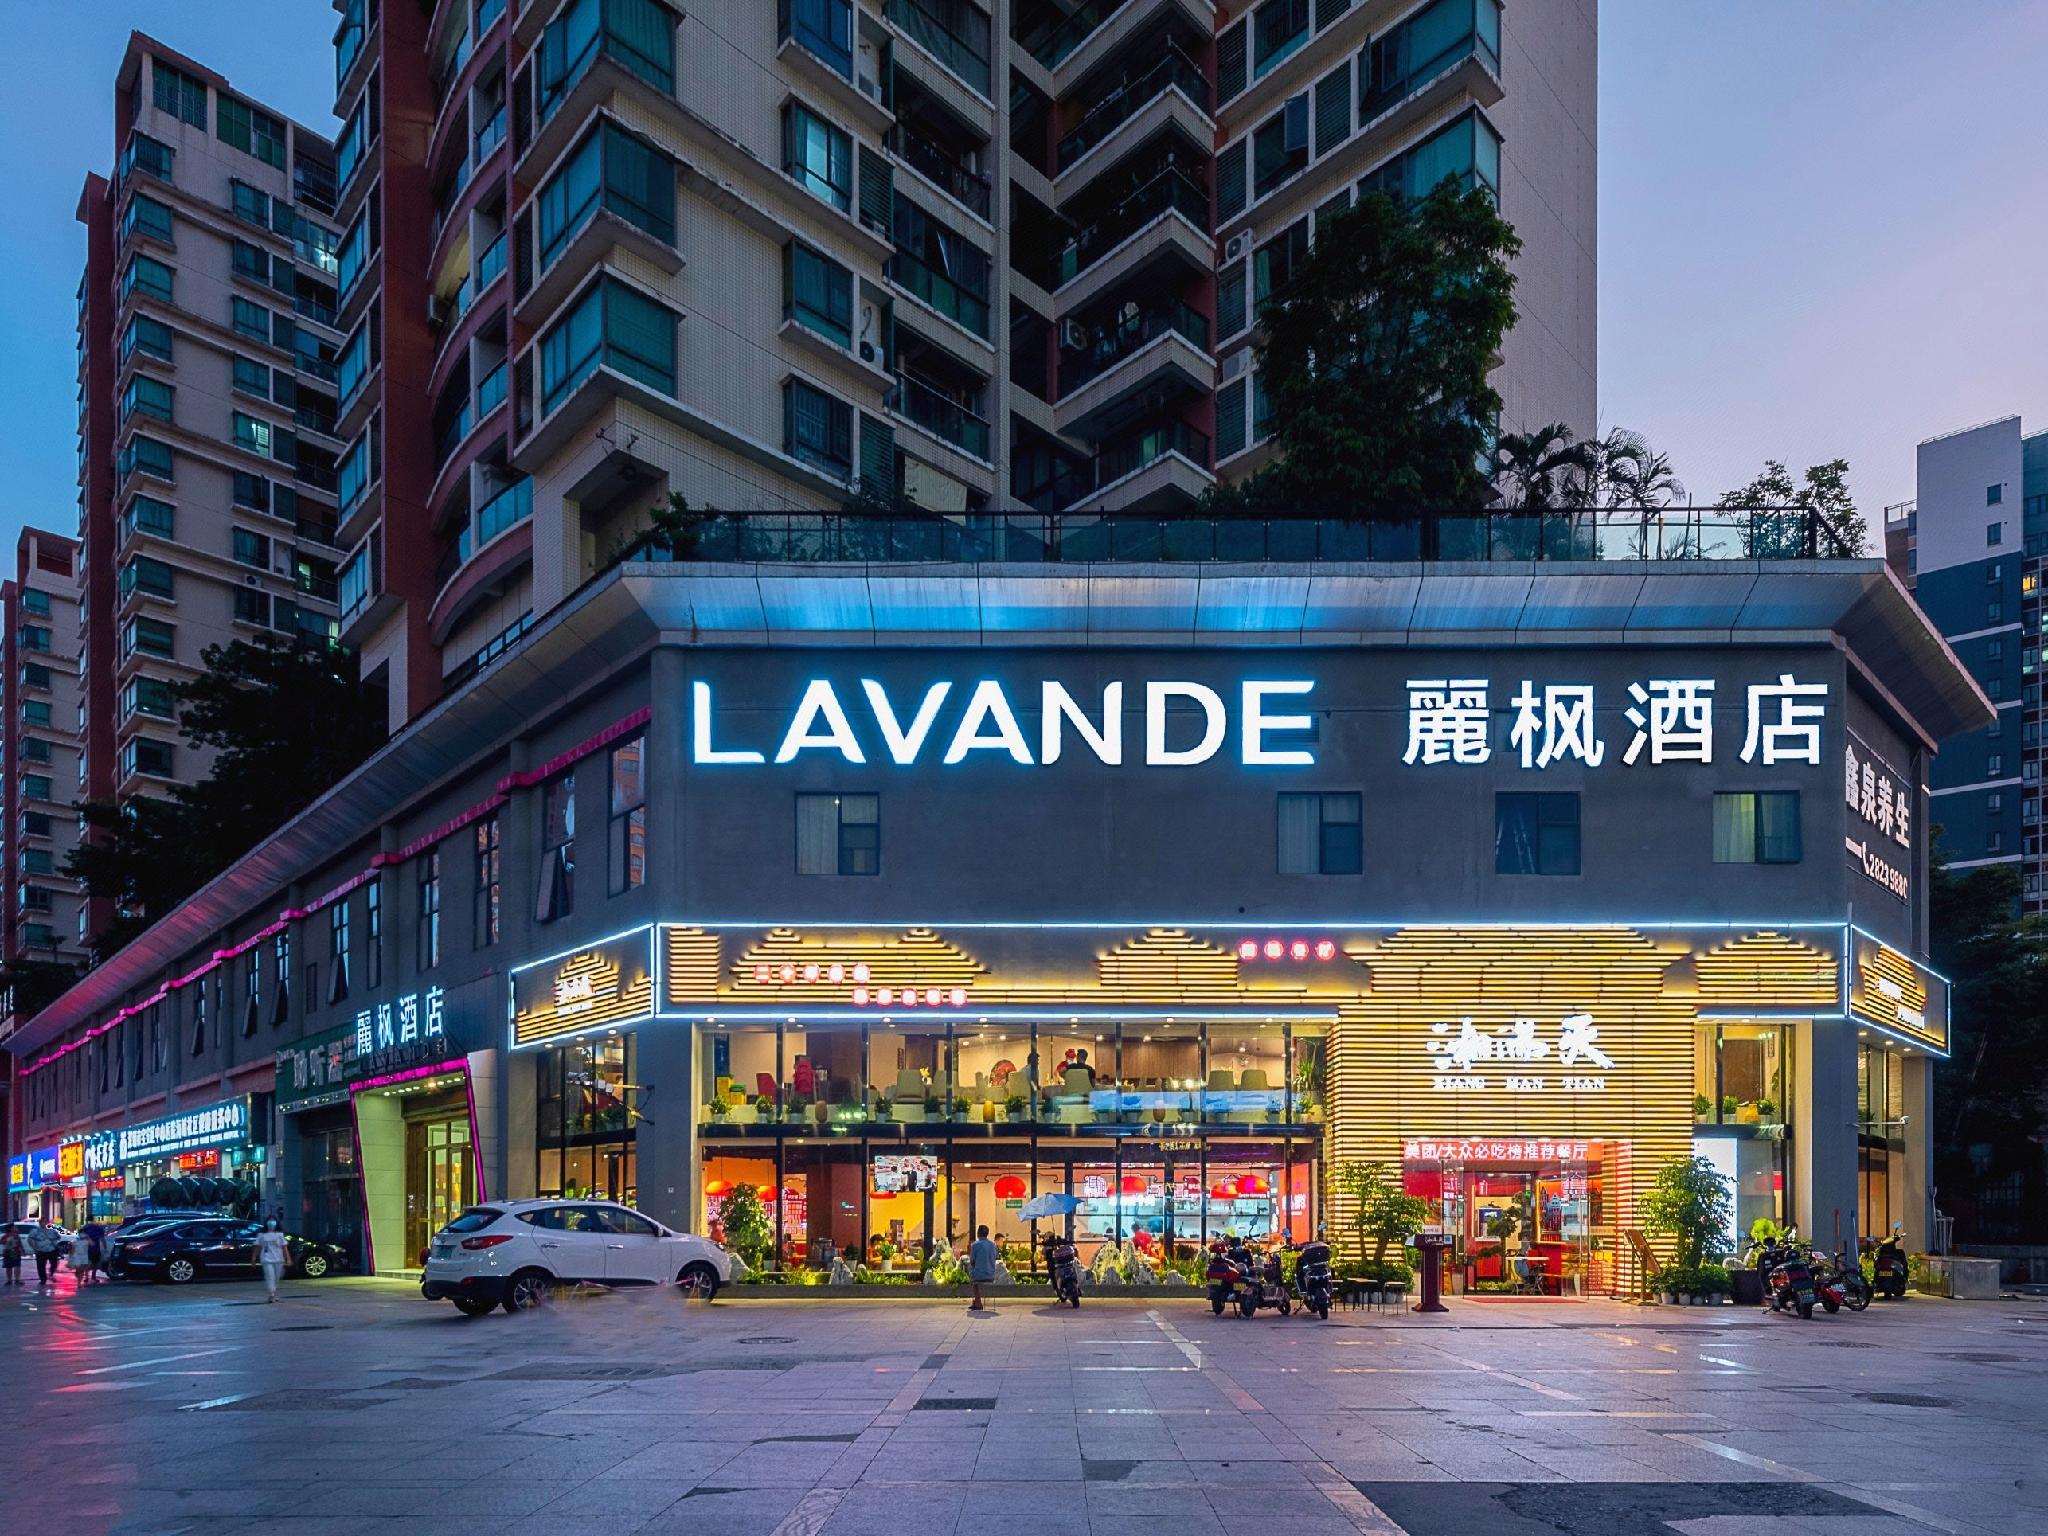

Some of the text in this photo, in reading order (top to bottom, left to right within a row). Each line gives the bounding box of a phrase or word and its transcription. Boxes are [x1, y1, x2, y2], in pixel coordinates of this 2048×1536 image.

[693, 679, 1315, 766] LAVANDE
[1402, 674, 1828, 769] 麗枫酒店
[356, 985, 445, 1057] 麗枫酒店
[1432, 1076, 1606, 1090] XIANG MAN TIAN
[1403, 1142, 1589, 1161] 美团/大众必吃榜推荐餐厅
